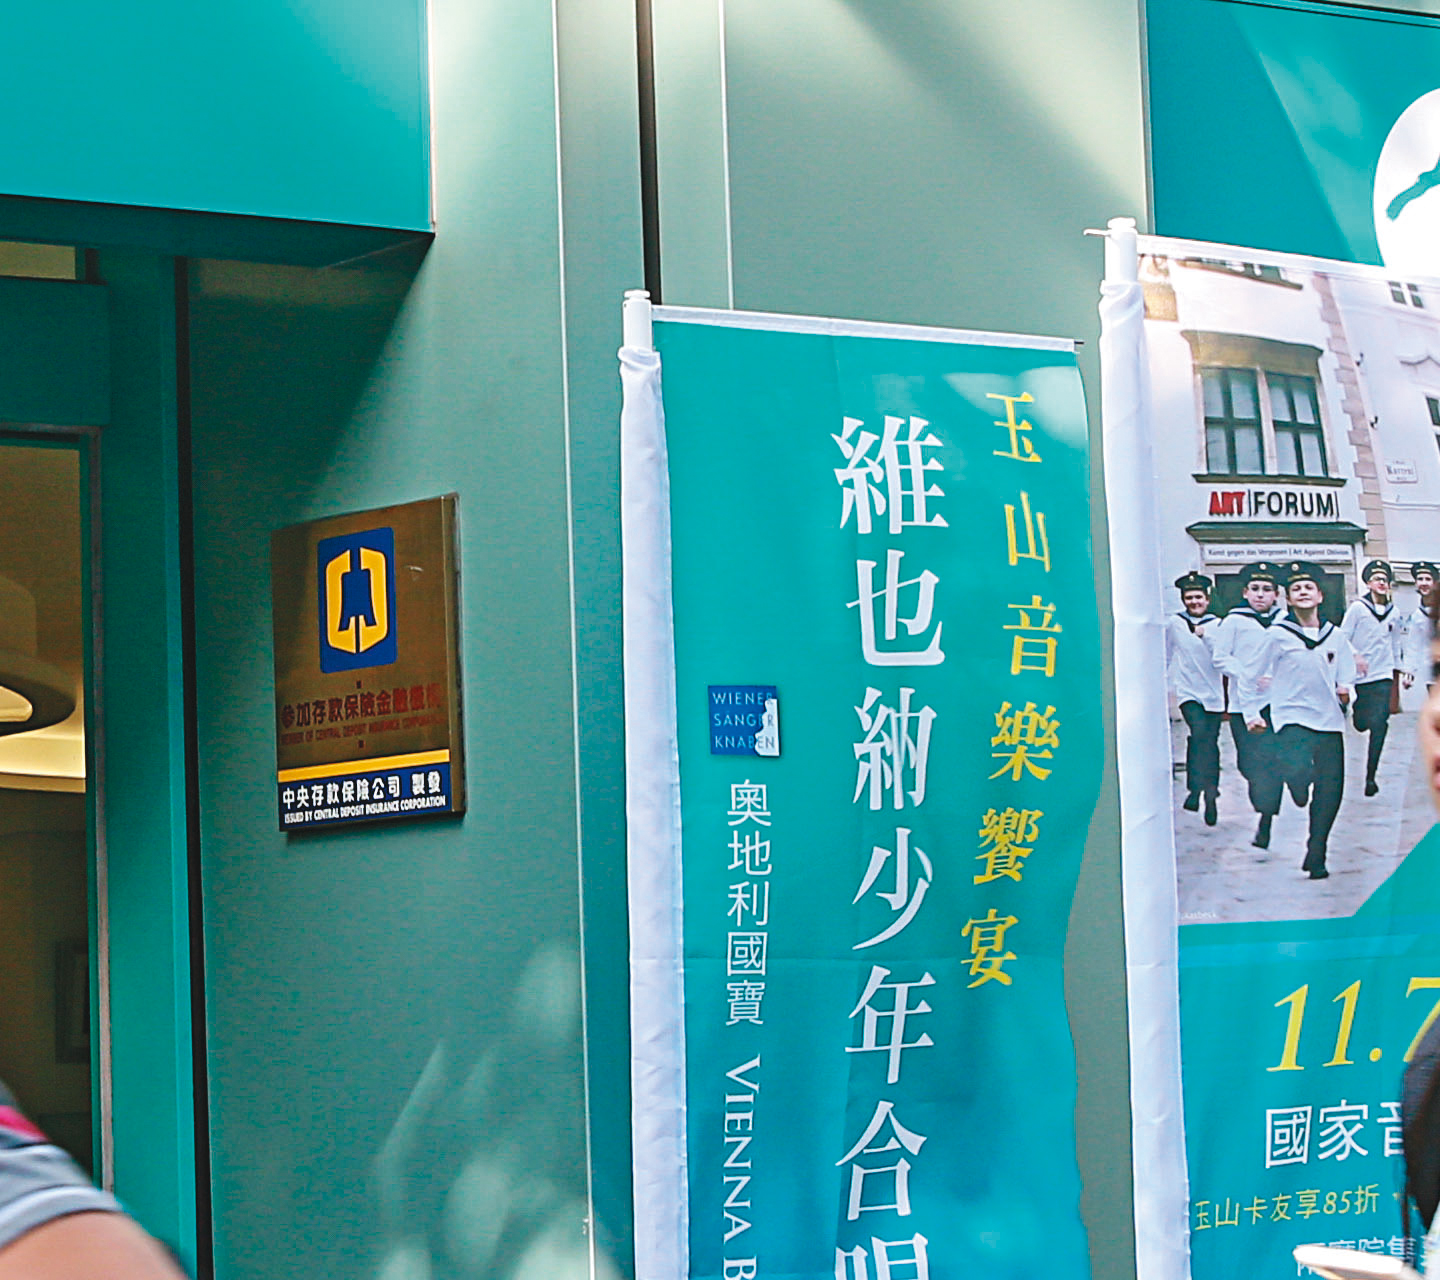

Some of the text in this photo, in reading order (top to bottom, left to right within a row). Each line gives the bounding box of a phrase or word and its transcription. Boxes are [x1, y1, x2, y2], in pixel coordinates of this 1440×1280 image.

[959, 391, 1063, 989] 玉山音樂饗宴
[283, 775, 401, 810] 中央存款保險公司
[314, 808, 340, 821] CENTRAL
[340, 804, 365, 818] DEPOSIT
[366, 800, 400, 815] INSURANCE
[400, 794, 447, 811] CORPORATION
[724, 779, 773, 1026] 奧地利國寶
[723, 1053, 761, 1244] VIENNA
